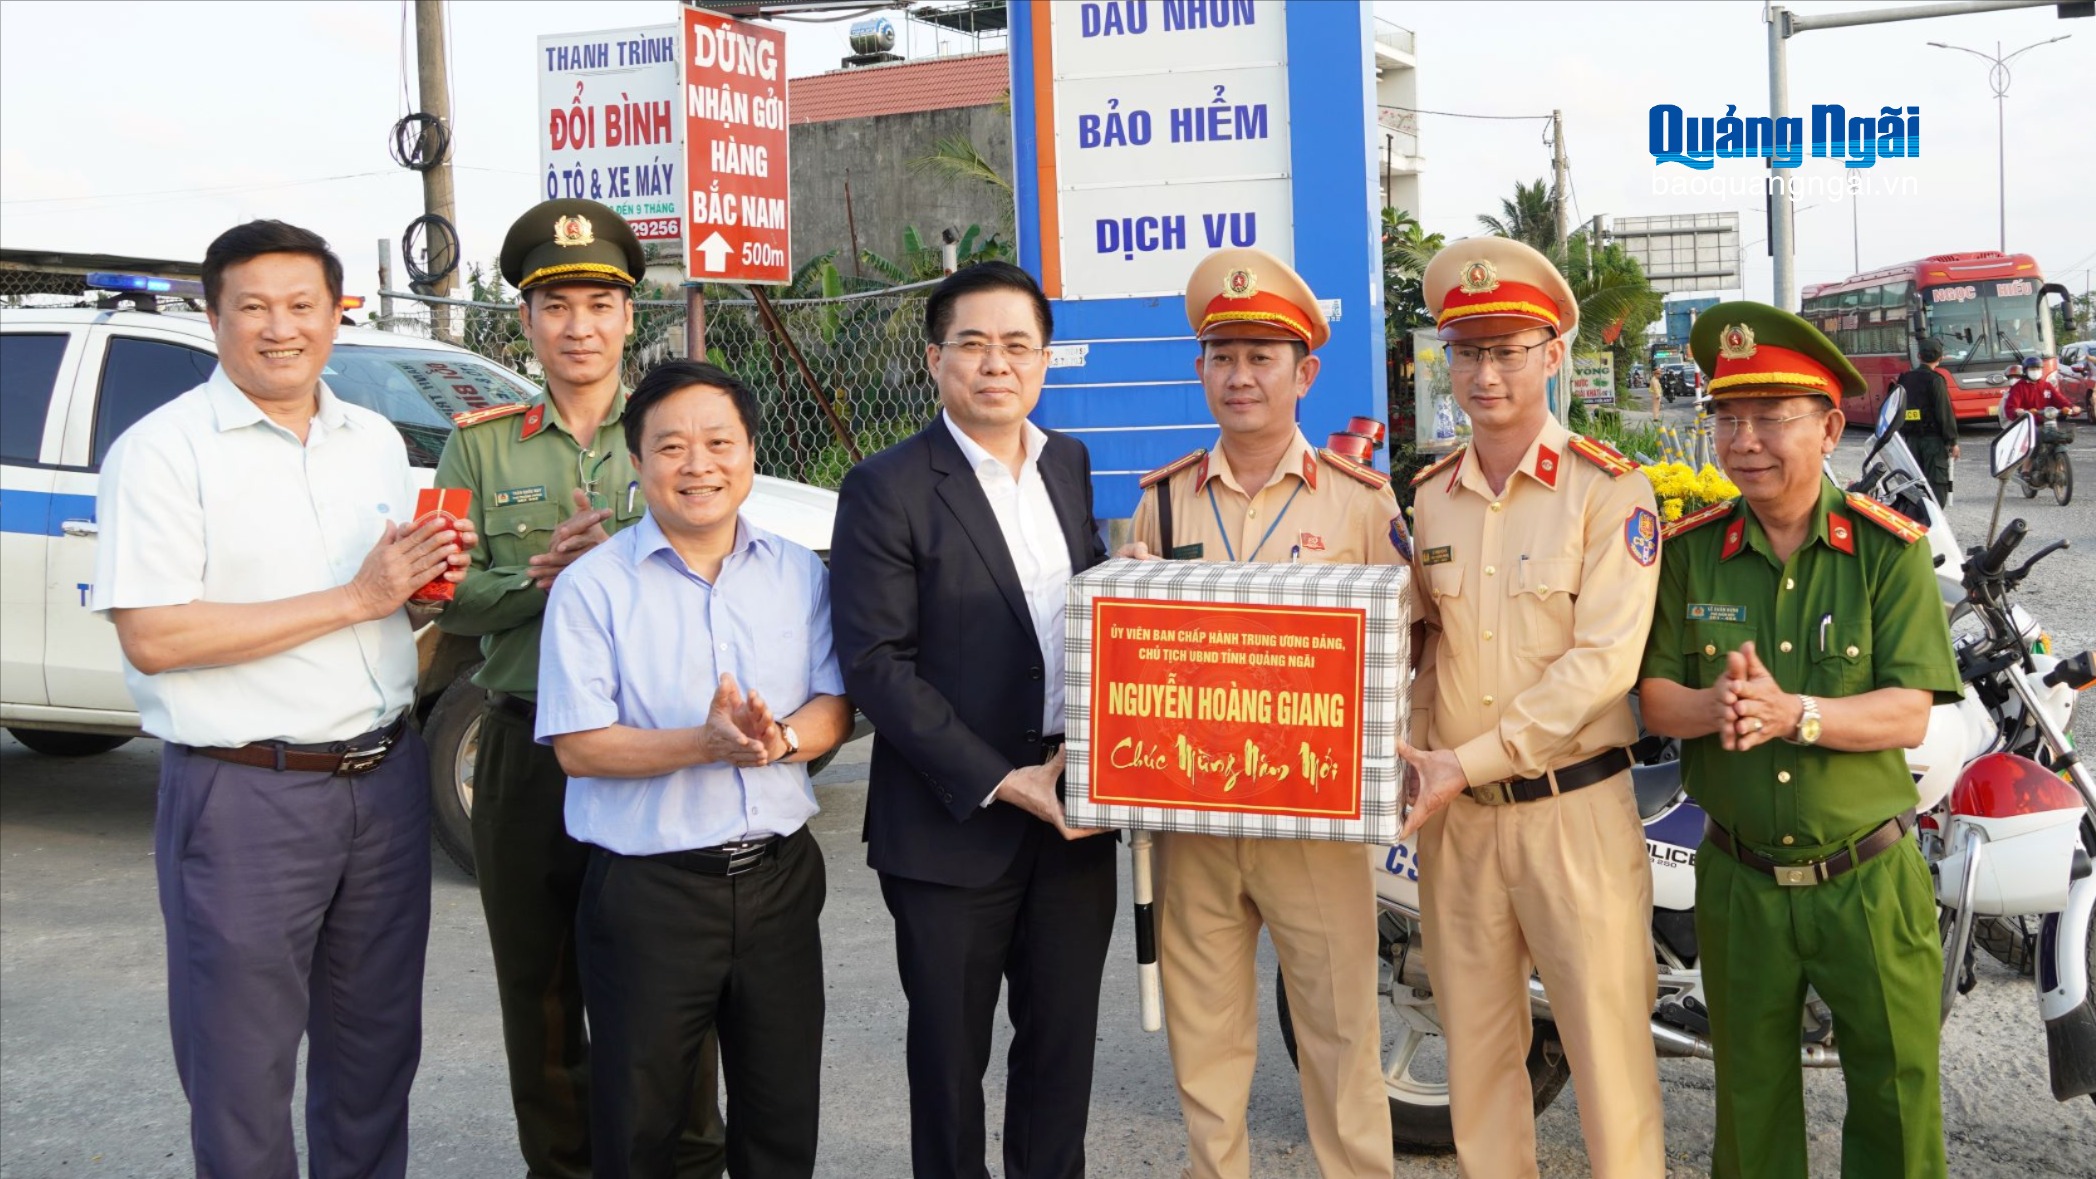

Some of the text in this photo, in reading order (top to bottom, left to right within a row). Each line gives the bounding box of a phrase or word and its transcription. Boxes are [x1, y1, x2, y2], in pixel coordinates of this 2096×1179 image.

[546, 34, 674, 72] THANH TRÌNH
[549, 80, 672, 151] ĐỔI BÌNH
[688, 83, 784, 131] NHẬN GỞI
[1079, 85, 1268, 149] BẢO HIỂM
[547, 156, 673, 200] Ô TÔ & XE MÁY
[711, 135, 768, 178] HÀNG
[636, 204, 642, 215] 9
[693, 179, 785, 230] BẮC NAM
[742, 241, 785, 267] 500m
[1096, 215, 1186, 261] DỊCH
[1932, 285, 1976, 303] NGỌC
[1110, 623, 1124, 639] ỦY
[1126, 625, 1151, 641] VIÊN
[1153, 629, 1176, 642] BAN
[1178, 627, 1206, 643] CHẤP
[1209, 630, 1239, 645] HÀNH
[1241, 633, 1277, 647] TRUNG
[1280, 634, 1310, 649] ƯƠNG
[1138, 645, 1315, 669] CHỦ TỊCH UBND TỈNH QUẢNG NGÃI
[1108, 672, 1345, 728] NGUYỄN HOÀNG GIANG
[1110, 736, 1168, 769] Chúc
[1299, 741, 1339, 793] Mới
